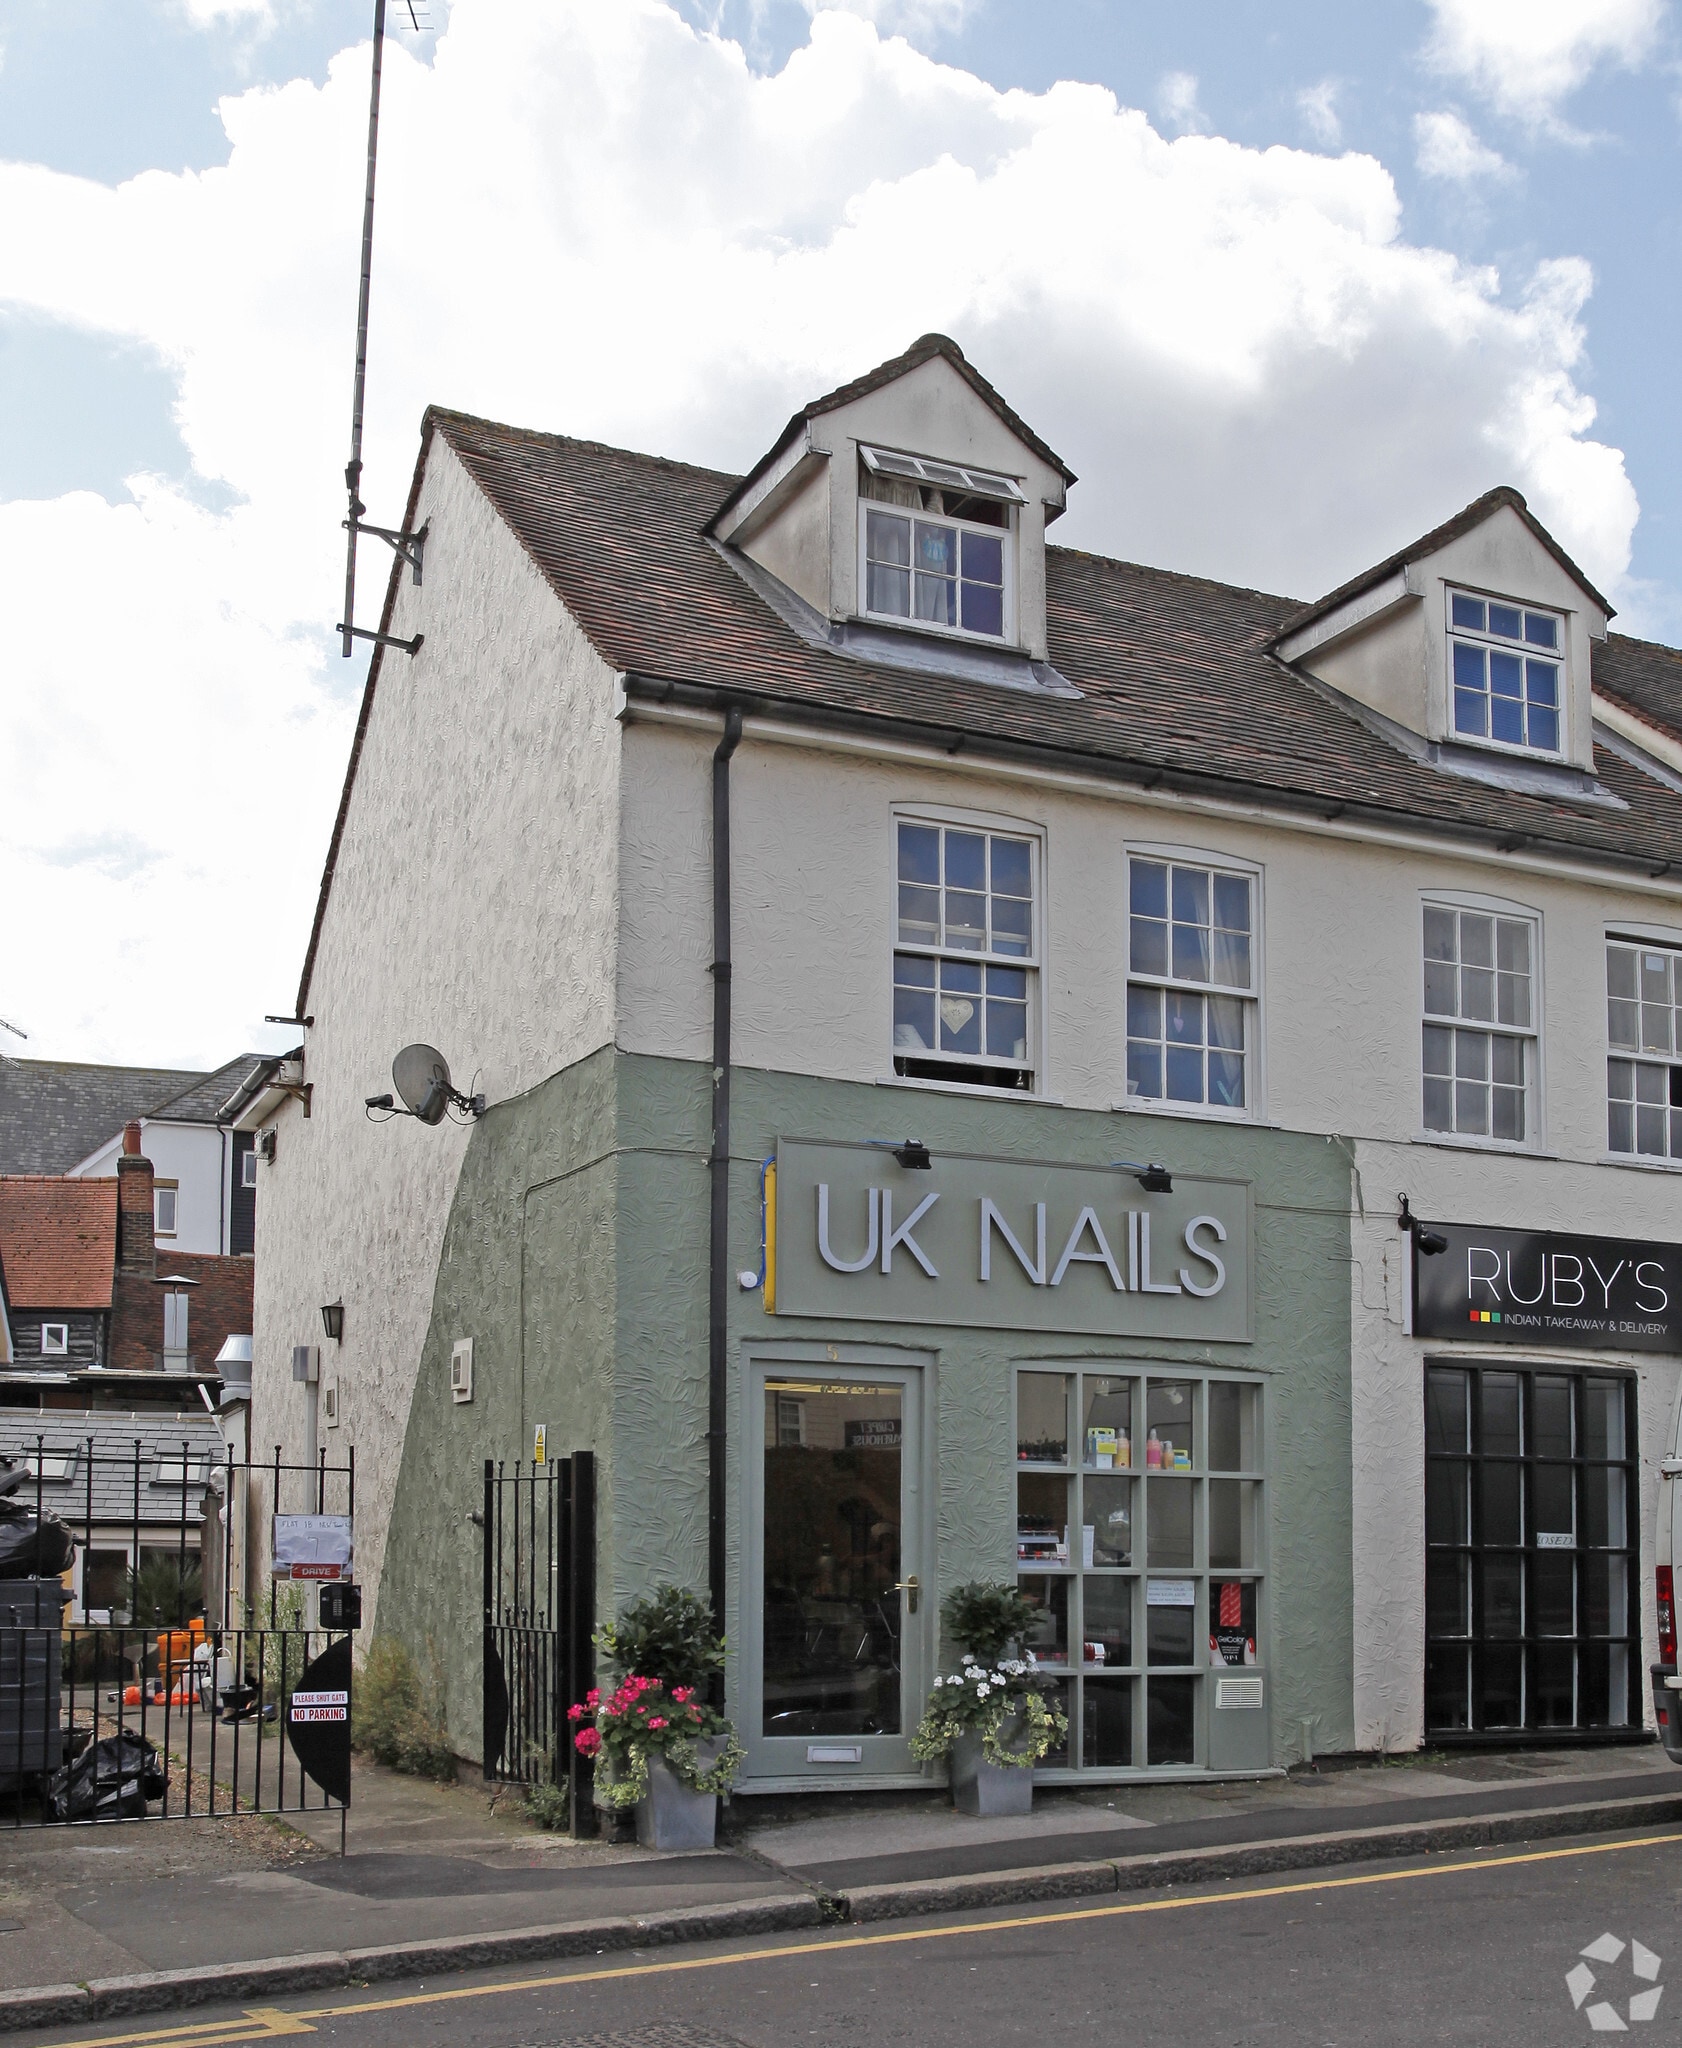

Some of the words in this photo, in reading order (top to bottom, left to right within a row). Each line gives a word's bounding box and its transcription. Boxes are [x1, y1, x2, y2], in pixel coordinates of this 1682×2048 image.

[814, 1183, 941, 1278] UK
[977, 1197, 1227, 1297] NAILS
[1467, 1246, 1668, 1313] RUBY'S
[1504, 1313, 1541, 1327] INDIAN
[1544, 1315, 1606, 1330] TAKEAWAY
[1608, 1320, 1617, 1331] &
[1619, 1321, 1668, 1335] DELIVERY
[826, 1344, 839, 1360] 5
[1537, 1536, 1573, 1546] LOSED
[302, 1567, 331, 1576] DRIVE
[295, 1695, 314, 1703] PLEASE
[316, 1694, 330, 1702] SHUT
[331, 1693, 345, 1702] GATE
[293, 1709, 305, 1720] NO
[308, 1708, 345, 1720] PARKING
